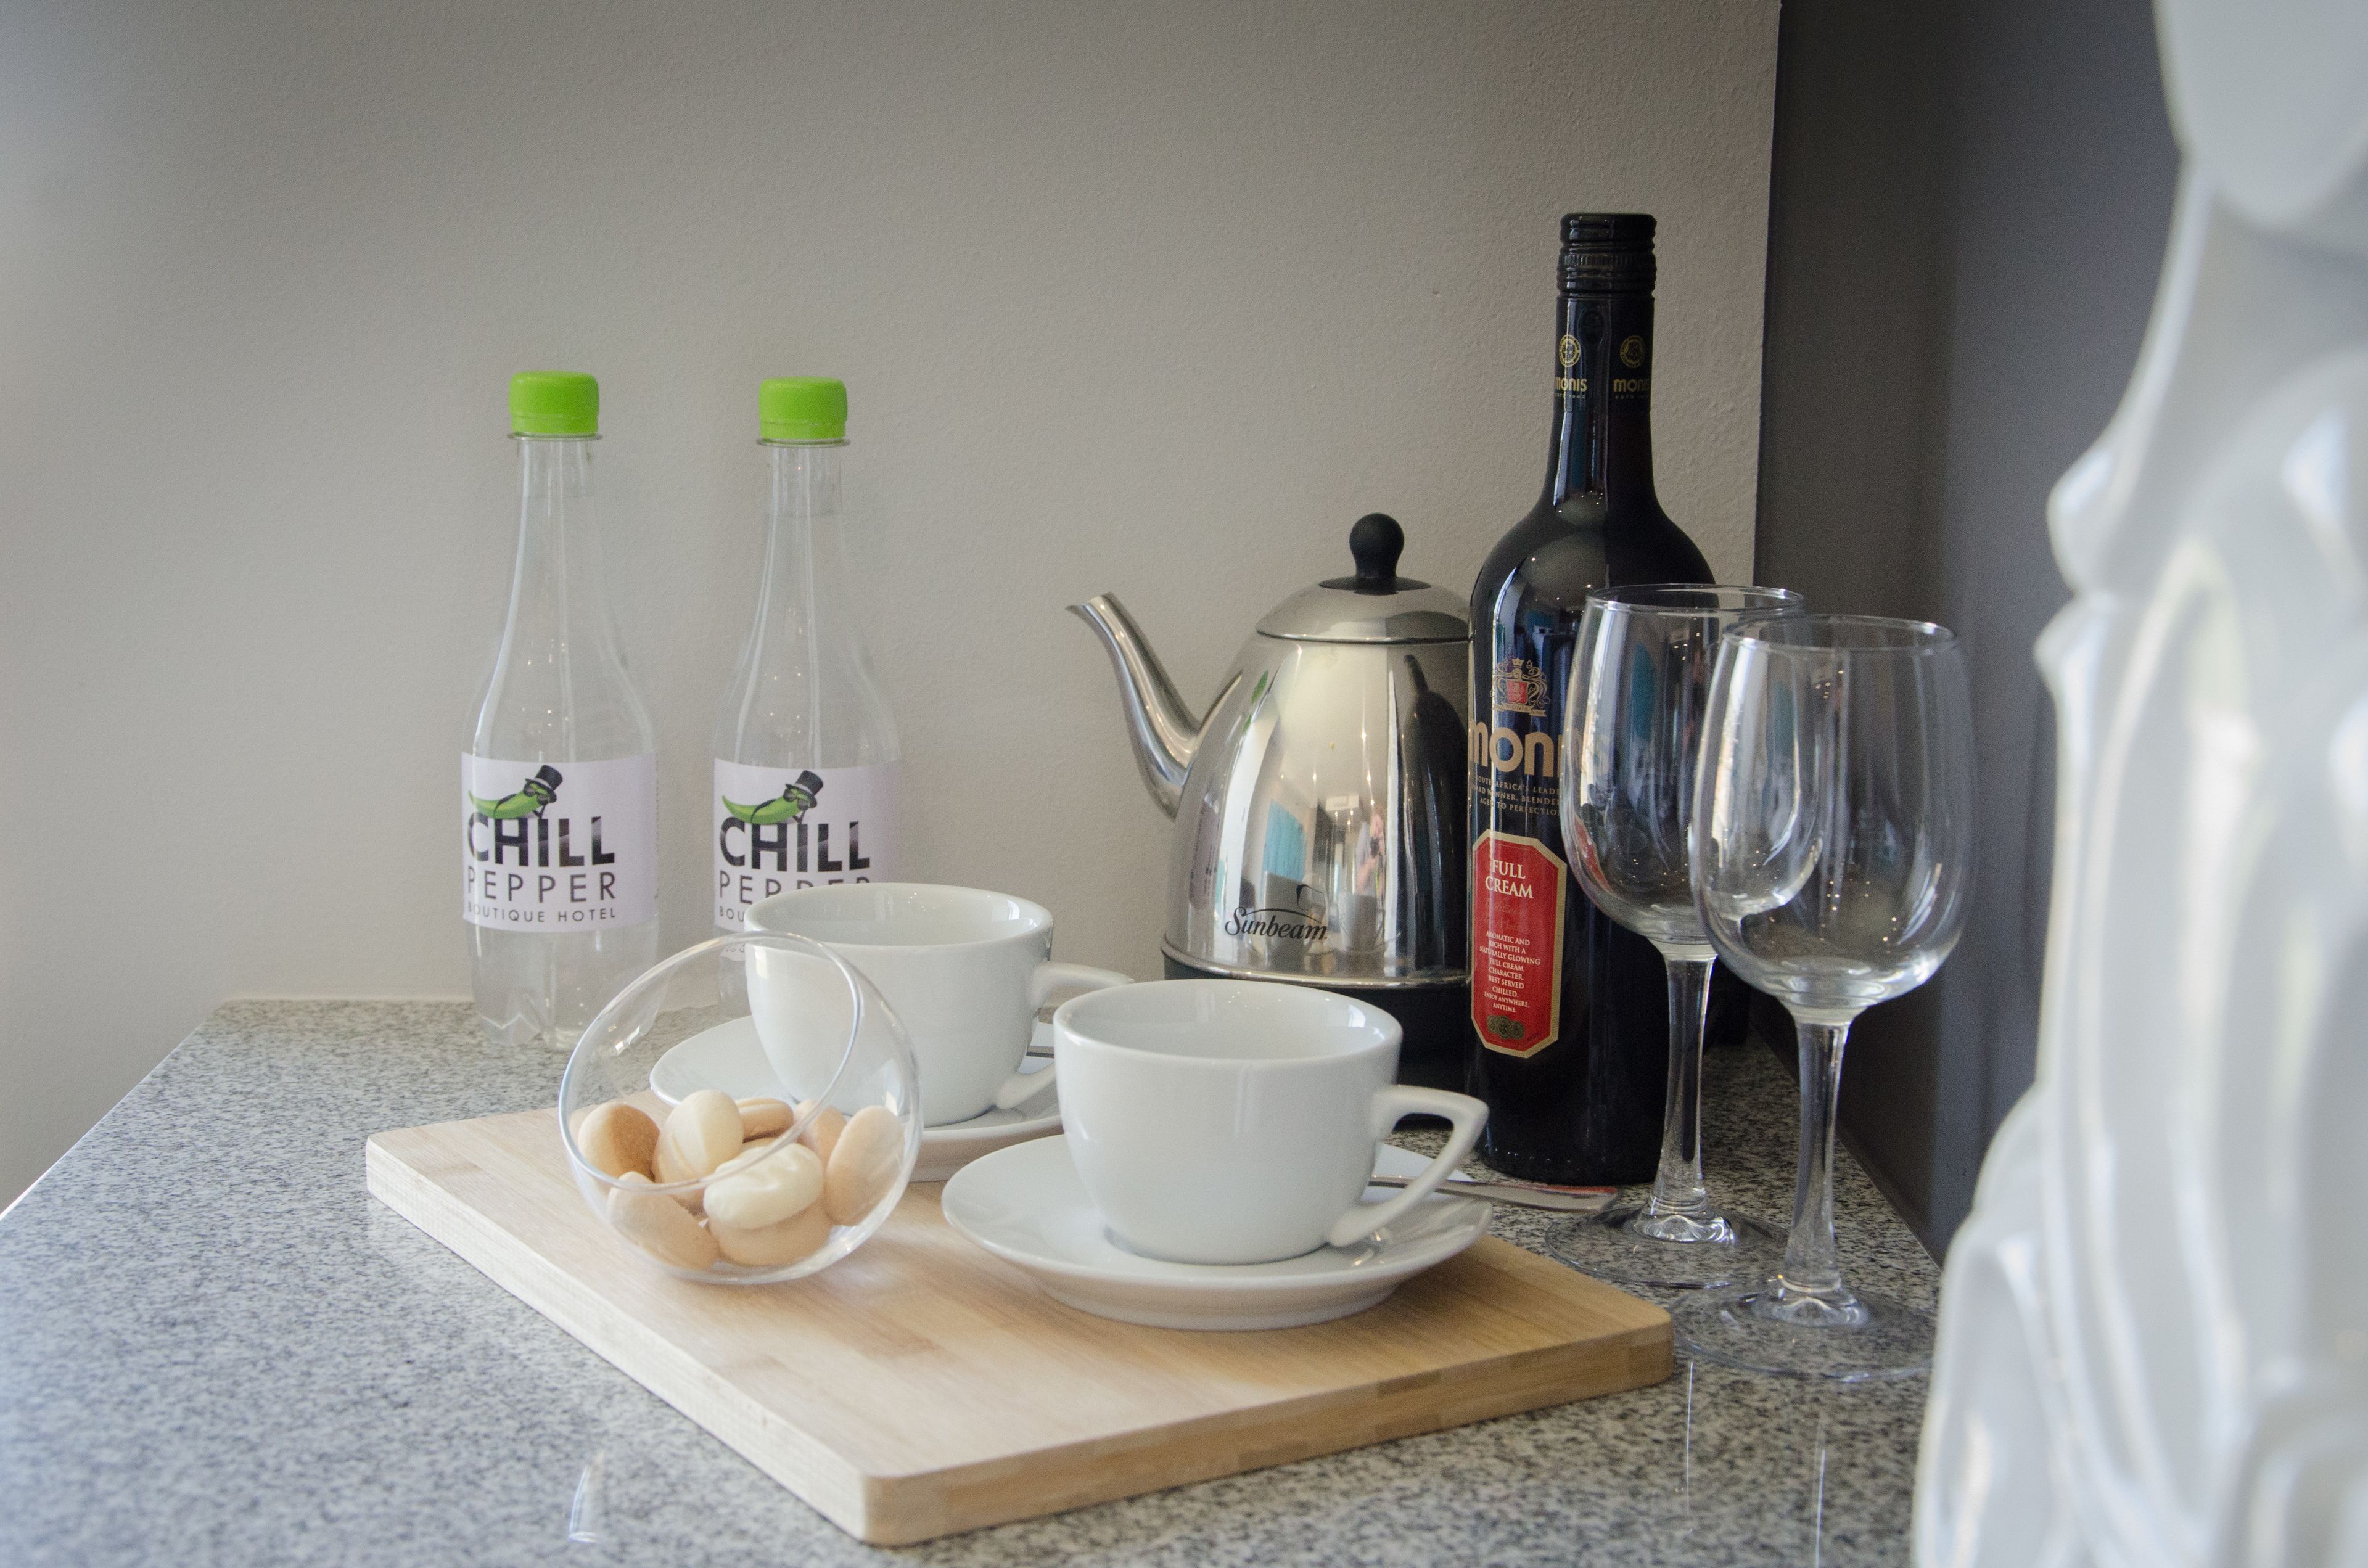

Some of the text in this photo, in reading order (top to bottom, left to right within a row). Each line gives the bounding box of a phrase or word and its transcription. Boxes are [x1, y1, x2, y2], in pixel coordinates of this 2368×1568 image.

[1496, 781, 1529, 792] AFRICA'S
[1496, 801, 1507, 810] TO
[1510, 804, 1560, 816] PERFECTIO
[467, 811, 615, 867] CHILL
[720, 816, 870, 873] CHILL
[1491, 859, 1526, 879] FULL
[467, 865, 615, 903] PEPPER
[720, 869, 870, 905] PEP
[1485, 876, 1534, 899] CREAM
[467, 901, 616, 922] BOUTIQUE HOTEL
[1224, 906, 1328, 940] Sunbeam
[1486, 931, 1515, 943] AROMATIC
[1489, 940, 1502, 950] RICH
[1503, 945, 1520, 953] WITH
[1479, 946, 1541, 966] NATURALLY GLOWING
[1489, 958, 1524, 972] FULL CREAM
[1489, 975, 1524, 990] BEST SERVED
[1484, 991, 1530, 1008] ENJOY ANYWHERE.
[1492, 1003, 1517, 1013] ANYTIME.
